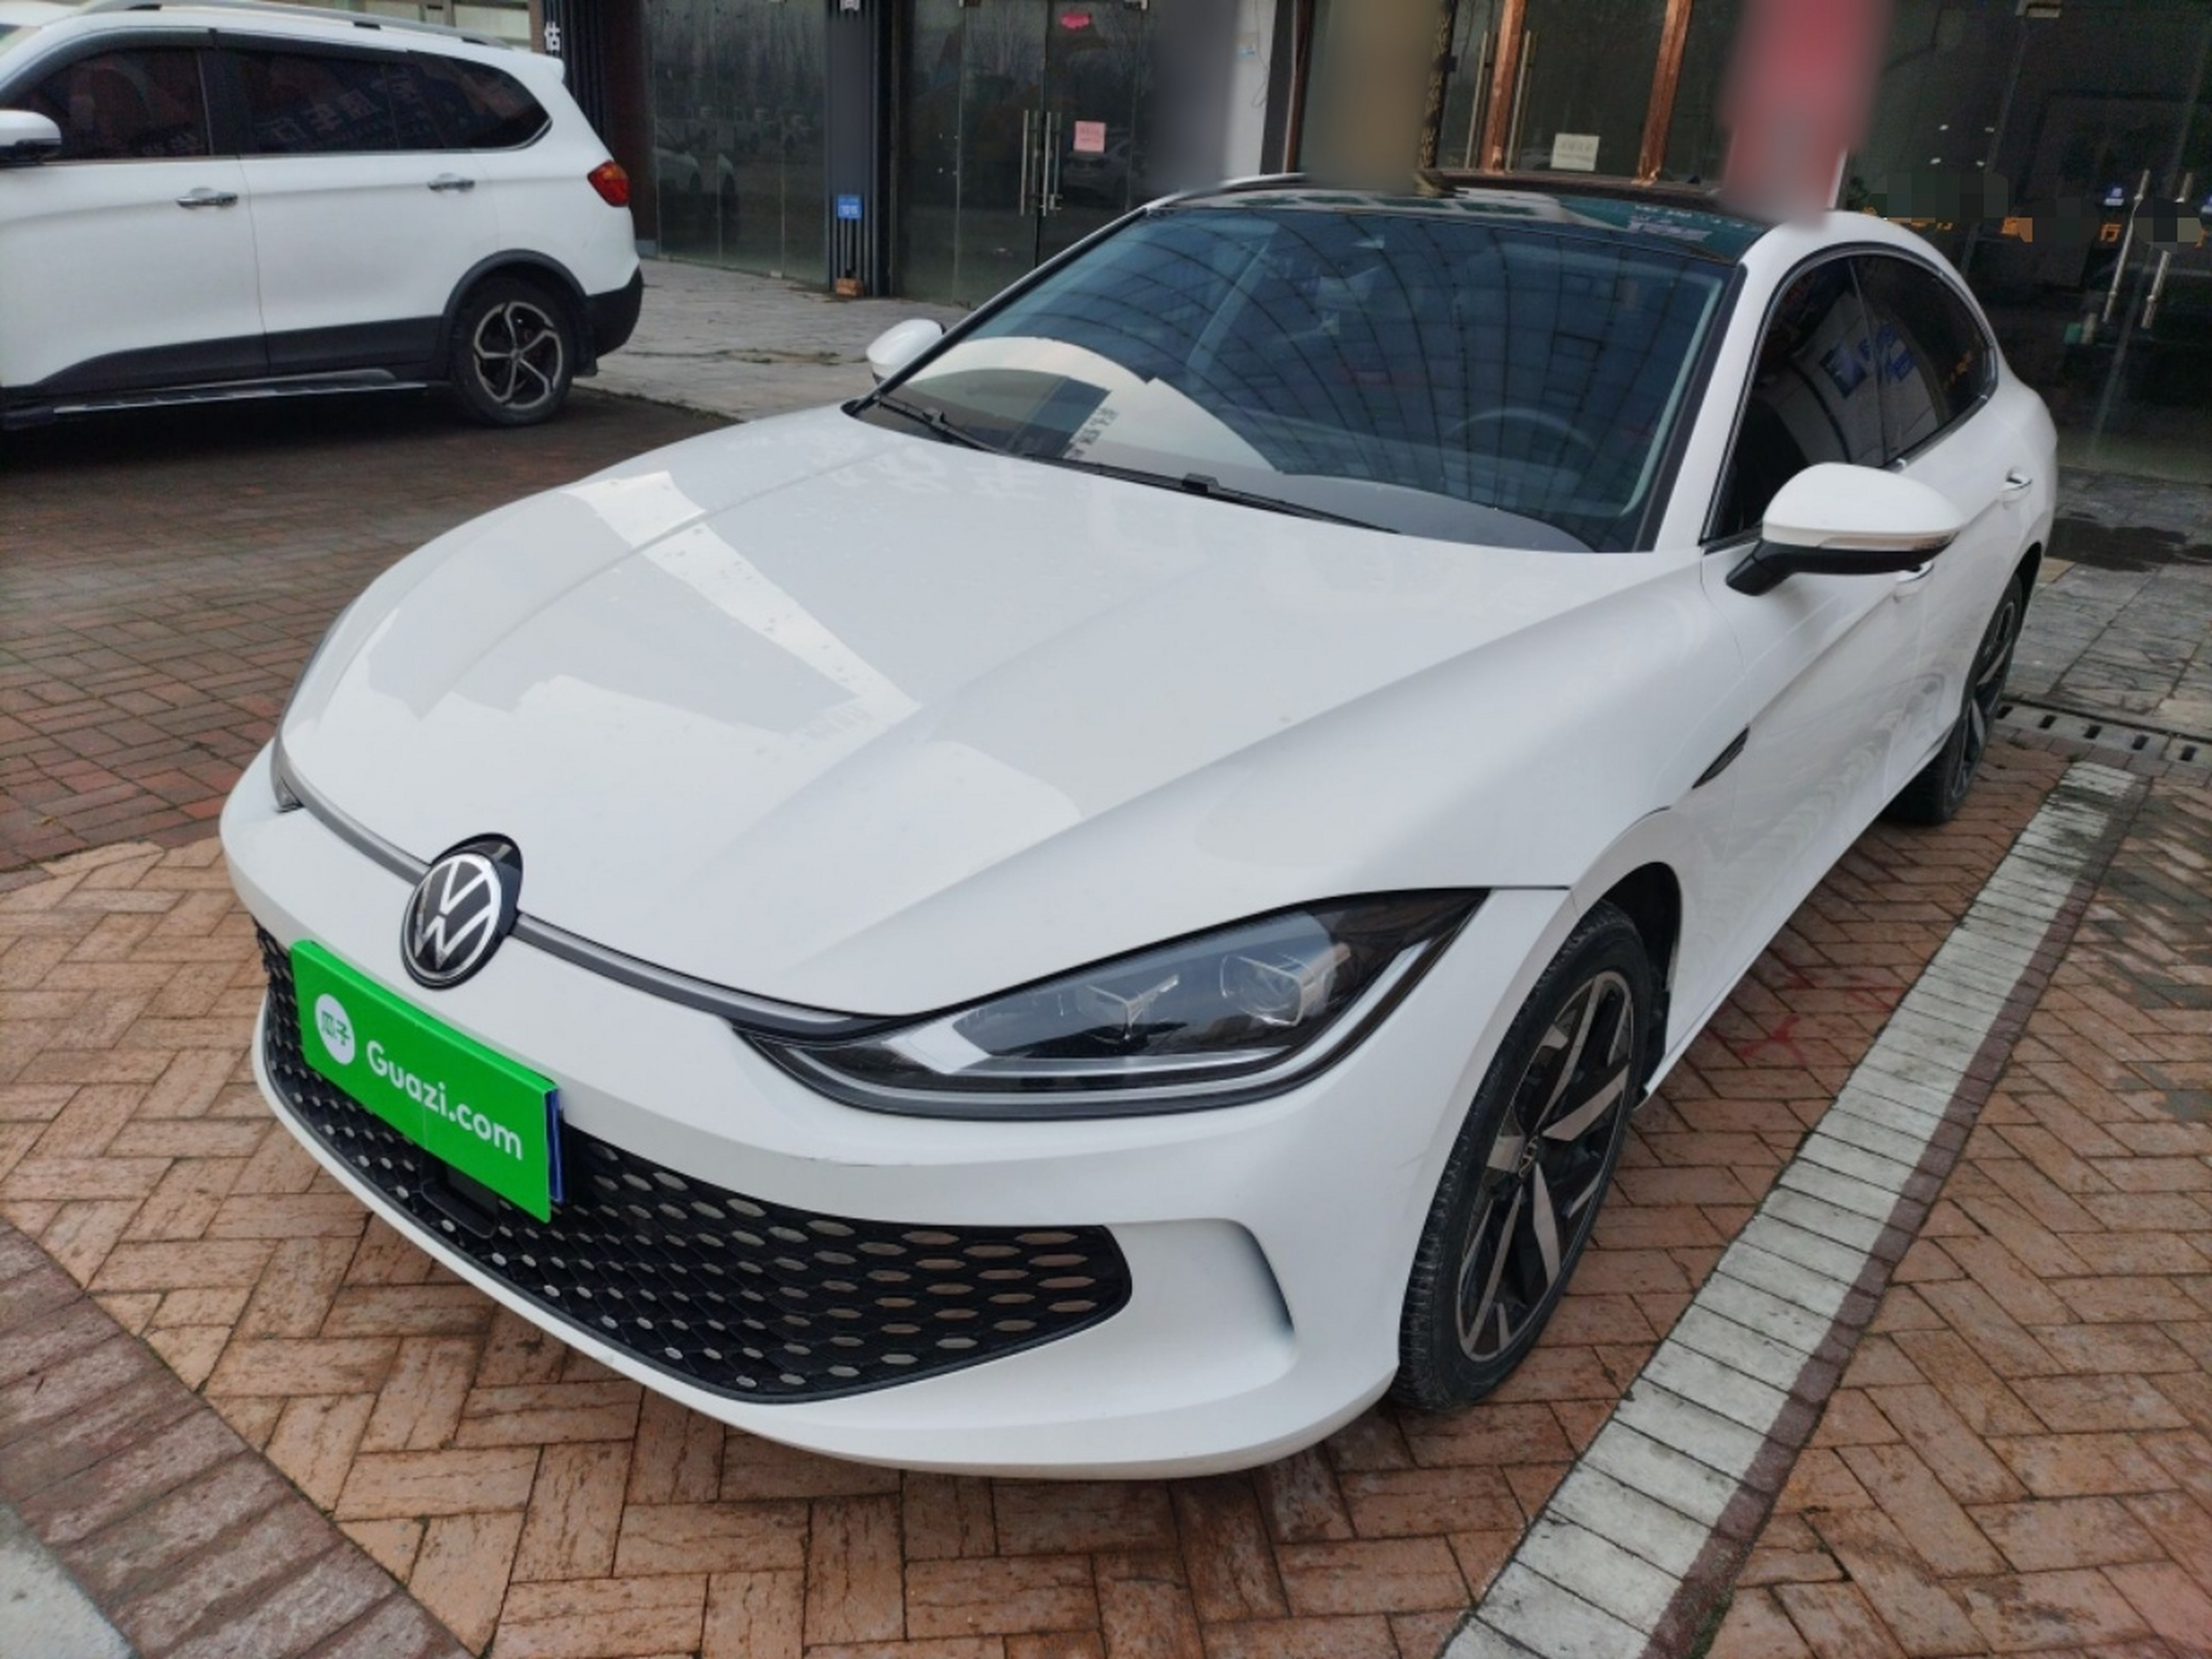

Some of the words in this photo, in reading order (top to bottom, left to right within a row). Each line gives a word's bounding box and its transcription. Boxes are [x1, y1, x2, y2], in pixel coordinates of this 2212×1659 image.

[406, 853, 501, 978] VW
[321, 1010, 350, 1047] 瓜子
[366, 1040, 522, 1161] Guazi.com
